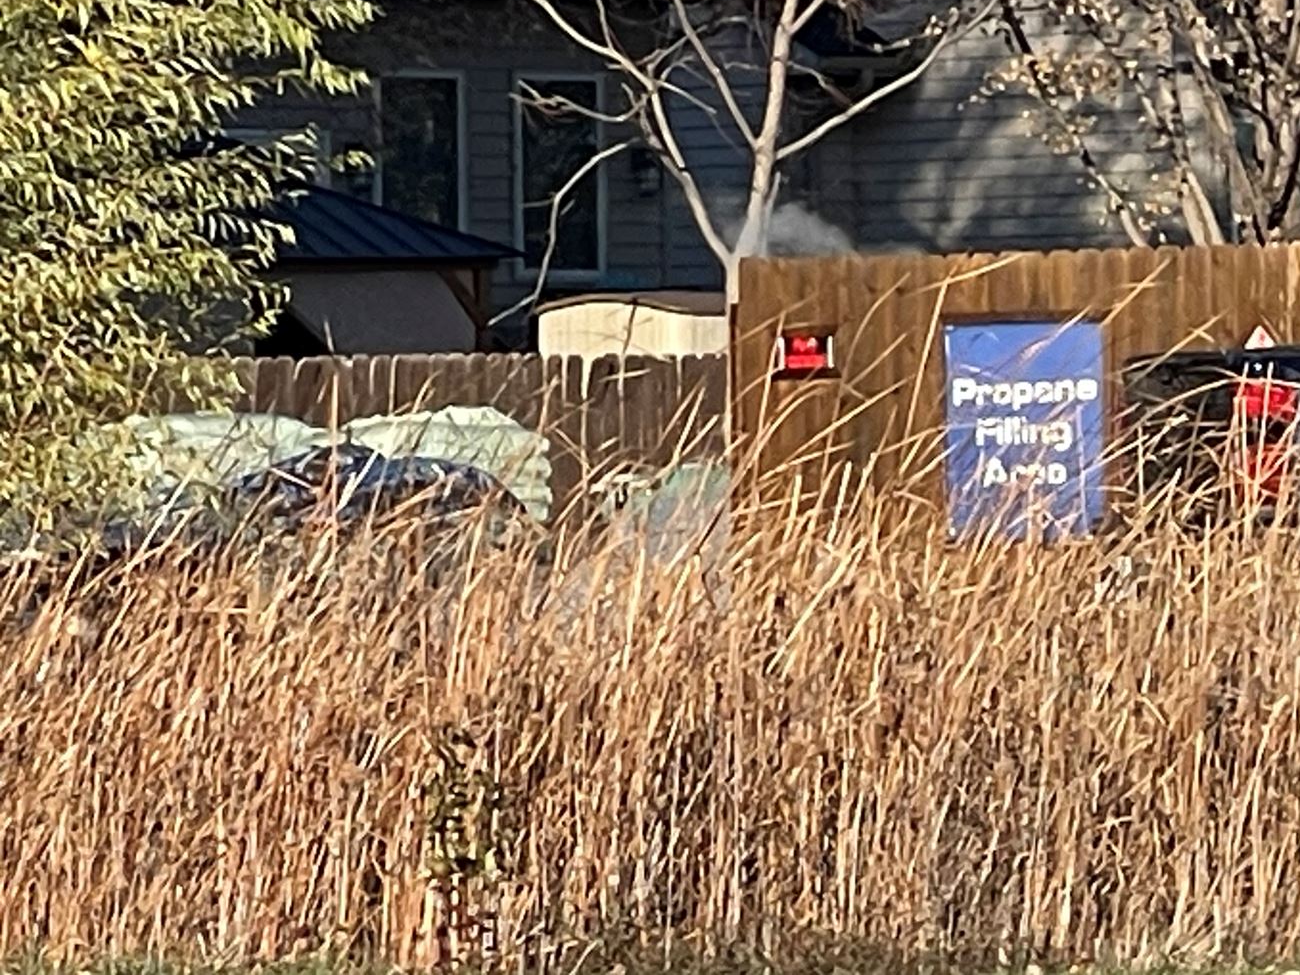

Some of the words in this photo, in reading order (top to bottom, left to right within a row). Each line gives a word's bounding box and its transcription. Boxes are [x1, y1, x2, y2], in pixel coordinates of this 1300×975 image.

[953, 378, 1098, 410] Propane
[975, 416, 1073, 451] Filling
[983, 457, 1067, 487] Area
